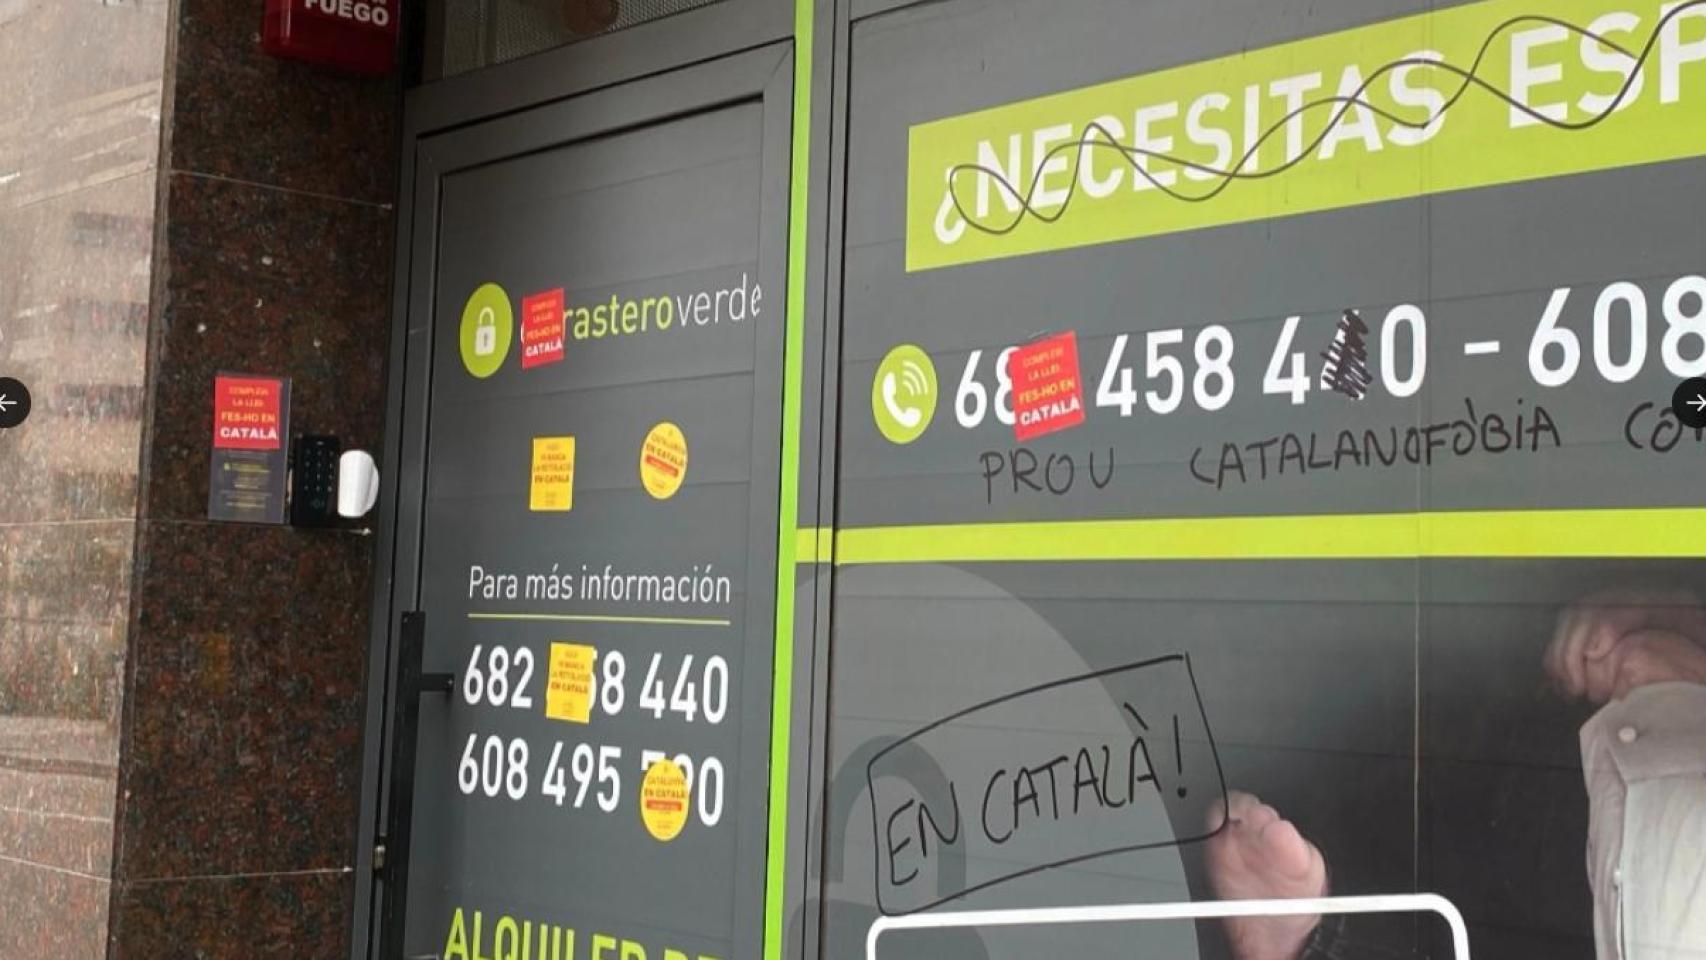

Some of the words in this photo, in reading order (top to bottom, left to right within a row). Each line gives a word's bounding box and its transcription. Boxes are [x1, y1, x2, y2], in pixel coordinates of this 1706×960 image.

[1096, 325, 1235, 416] 458
[1528, 275, 1706, 388] 608
[1059, 378, 1075, 392] EN
[980, 446, 1114, 504] PROU
[469, 565, 519, 600] Para
[525, 562, 573, 600] más
[580, 564, 731, 604] información
[463, 644, 535, 708] 682
[639, 653, 729, 724] 440
[458, 733, 529, 801] 608
[542, 741, 622, 812] 495
[887, 781, 959, 886] EN
